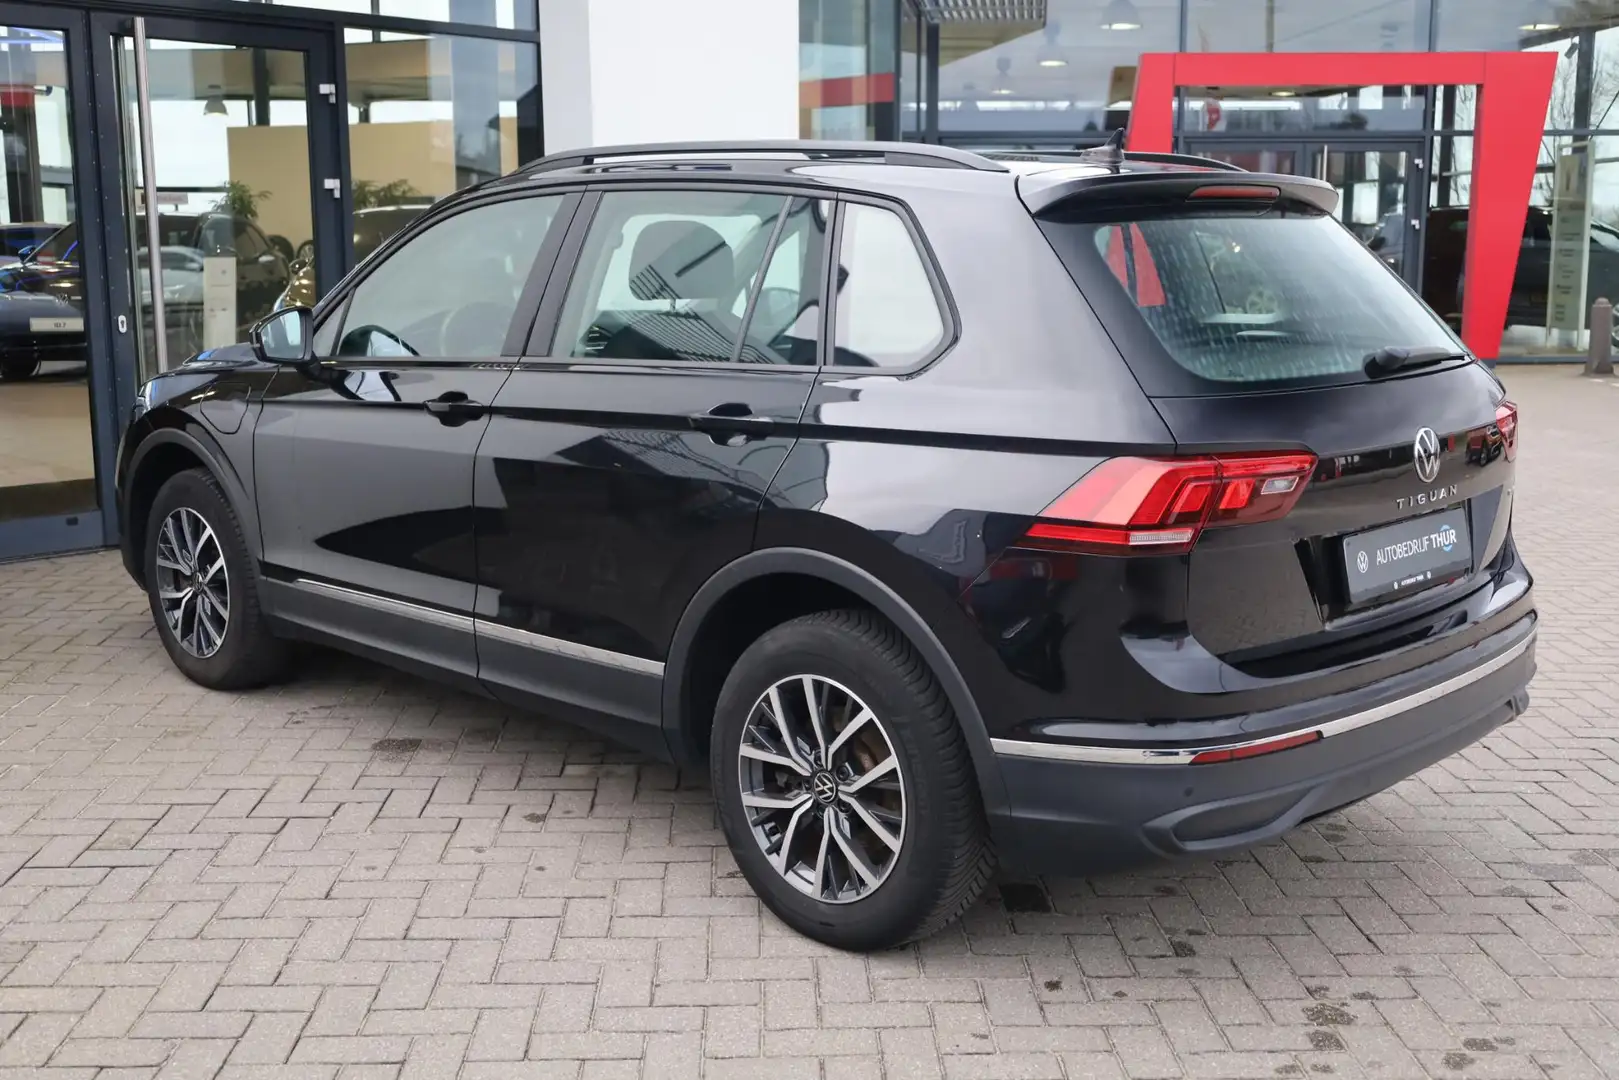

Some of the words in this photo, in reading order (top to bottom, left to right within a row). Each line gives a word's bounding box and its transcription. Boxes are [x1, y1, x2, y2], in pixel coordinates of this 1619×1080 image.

[1396, 484, 1458, 510] TIGUAN
[1376, 536, 1430, 566] AUTOBEDRIJF
[1430, 529, 1457, 549] THUR
